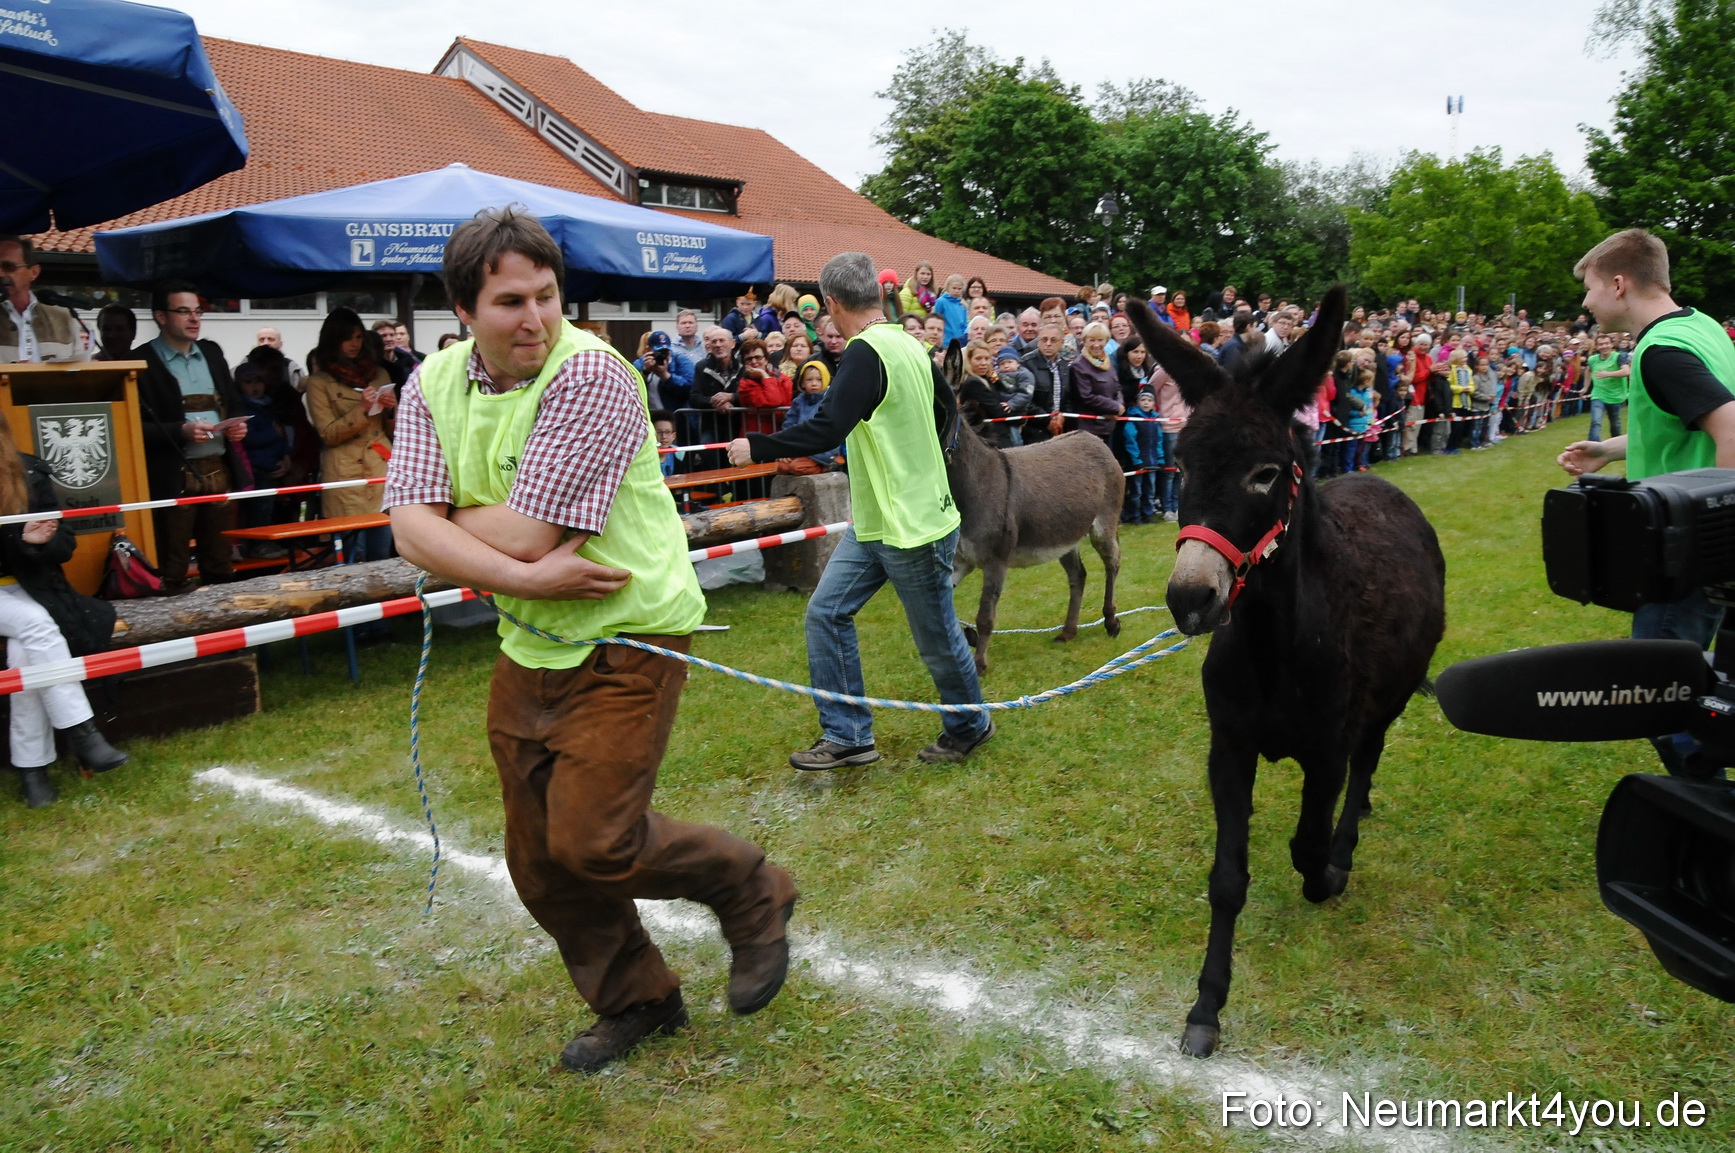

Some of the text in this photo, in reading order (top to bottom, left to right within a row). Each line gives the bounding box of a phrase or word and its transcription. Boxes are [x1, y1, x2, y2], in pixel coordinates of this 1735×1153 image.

[0, 8, 47, 27] markt's
[345, 223, 455, 237] GANSBRÄU
[406, 254, 444, 265] Schluc
[1536, 681, 1692, 708] www.intv.de
[1703, 698, 1731, 712] SONY
